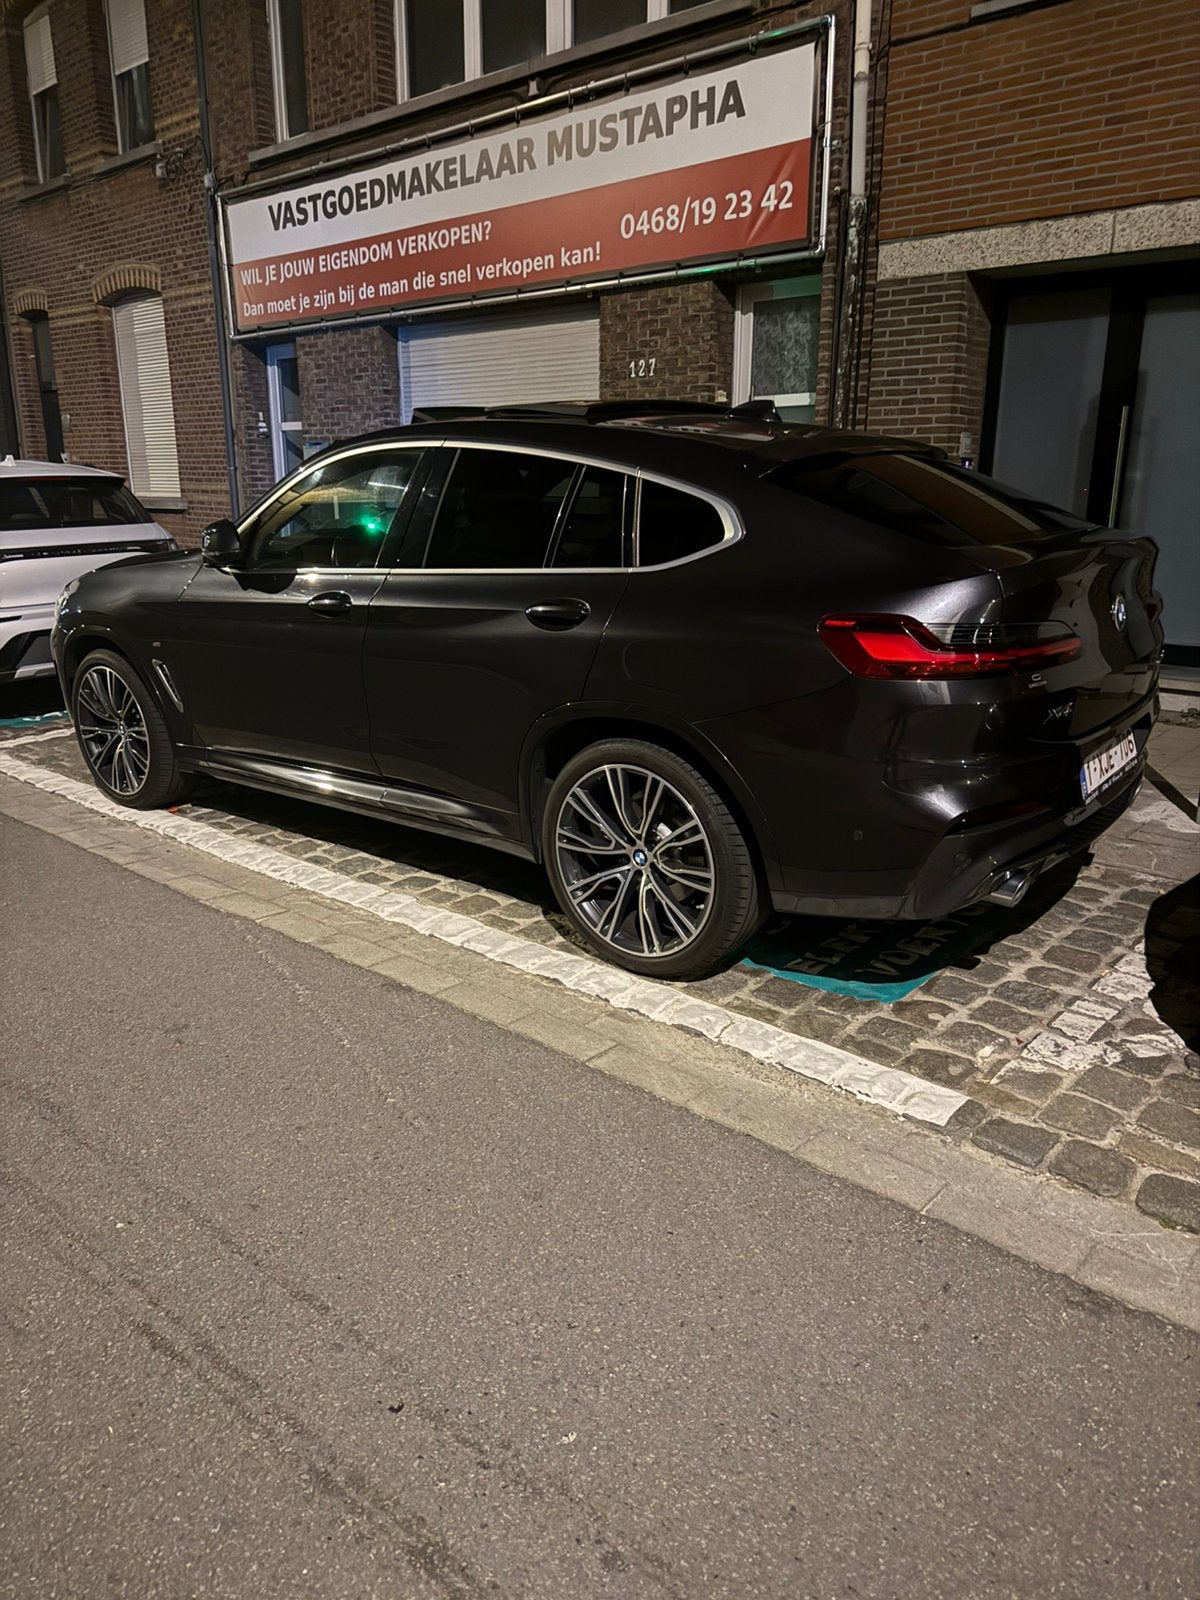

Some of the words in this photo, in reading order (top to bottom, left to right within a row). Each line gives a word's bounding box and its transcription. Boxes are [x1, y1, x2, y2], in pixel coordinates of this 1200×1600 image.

[267, 136, 536, 231] VASTGOEDMAKELAAR
[546, 79, 747, 166] MUSTAPHA
[620, 196, 717, 240] 0468/19
[723, 189, 753, 221] 23
[760, 180, 794, 213] 42
[240, 267, 263, 286] WIL
[265, 264, 277, 286] JE
[280, 256, 315, 284] JOUW
[318, 240, 393, 273] EIGENDOM
[396, 220, 493, 257] VERKOPEN?
[243, 301, 264, 317] Dan
[267, 295, 297, 314] moet
[299, 292, 311, 314] je
[313, 289, 335, 310] zijn
[338, 286, 356, 306] bij
[358, 282, 375, 300] de
[378, 277, 409, 297] man
[412, 270, 436, 292] die
[439, 263, 472, 287] snel
[475, 252, 555, 280] verkopen
[560, 240, 601, 268] kan!
[628, 357, 656, 378] 127
